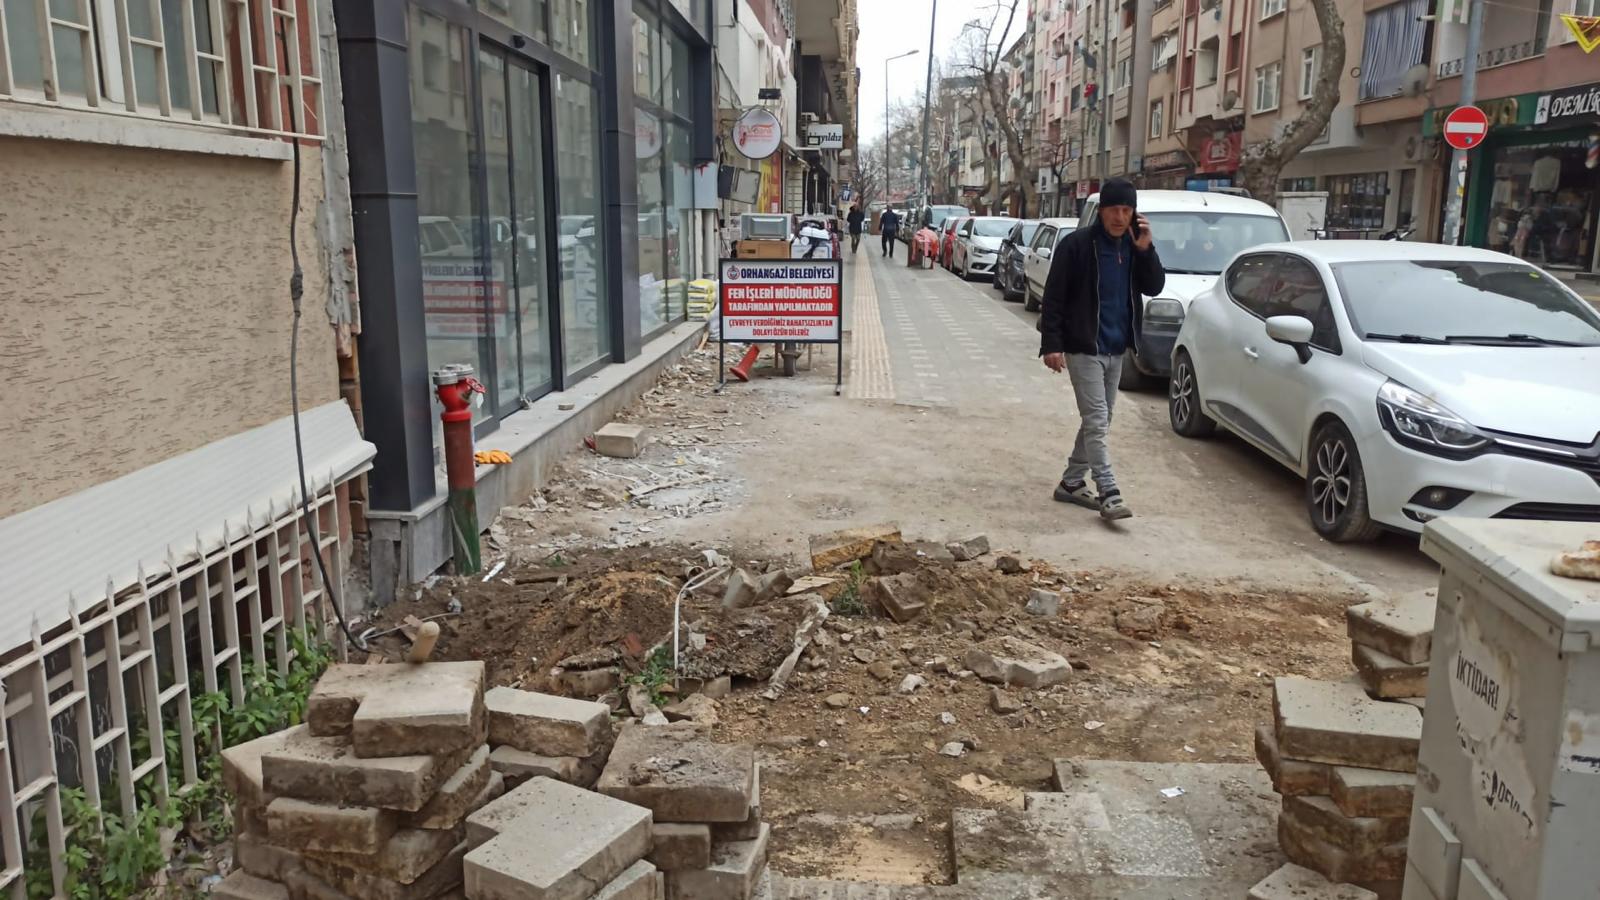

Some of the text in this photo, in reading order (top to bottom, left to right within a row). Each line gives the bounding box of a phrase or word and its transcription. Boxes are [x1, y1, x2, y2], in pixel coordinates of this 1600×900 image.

[741, 265, 834, 279] ORHANGAZİ BELEDİYESİ
[728, 286, 832, 301] FEN İŞLERİ MÜDÜRLÜĞÜ
[728, 302, 833, 312] TARAFINDAN YAPILMAKTADIR
[729, 318, 833, 328] ÇEVREYE VERDİĞİMİZ RAHATSIZLIKTAN
[752, 327, 809, 336] DOLAYI ÖZÜR DİLERİZ
[1456, 650, 1500, 711] İKTİDAR!
